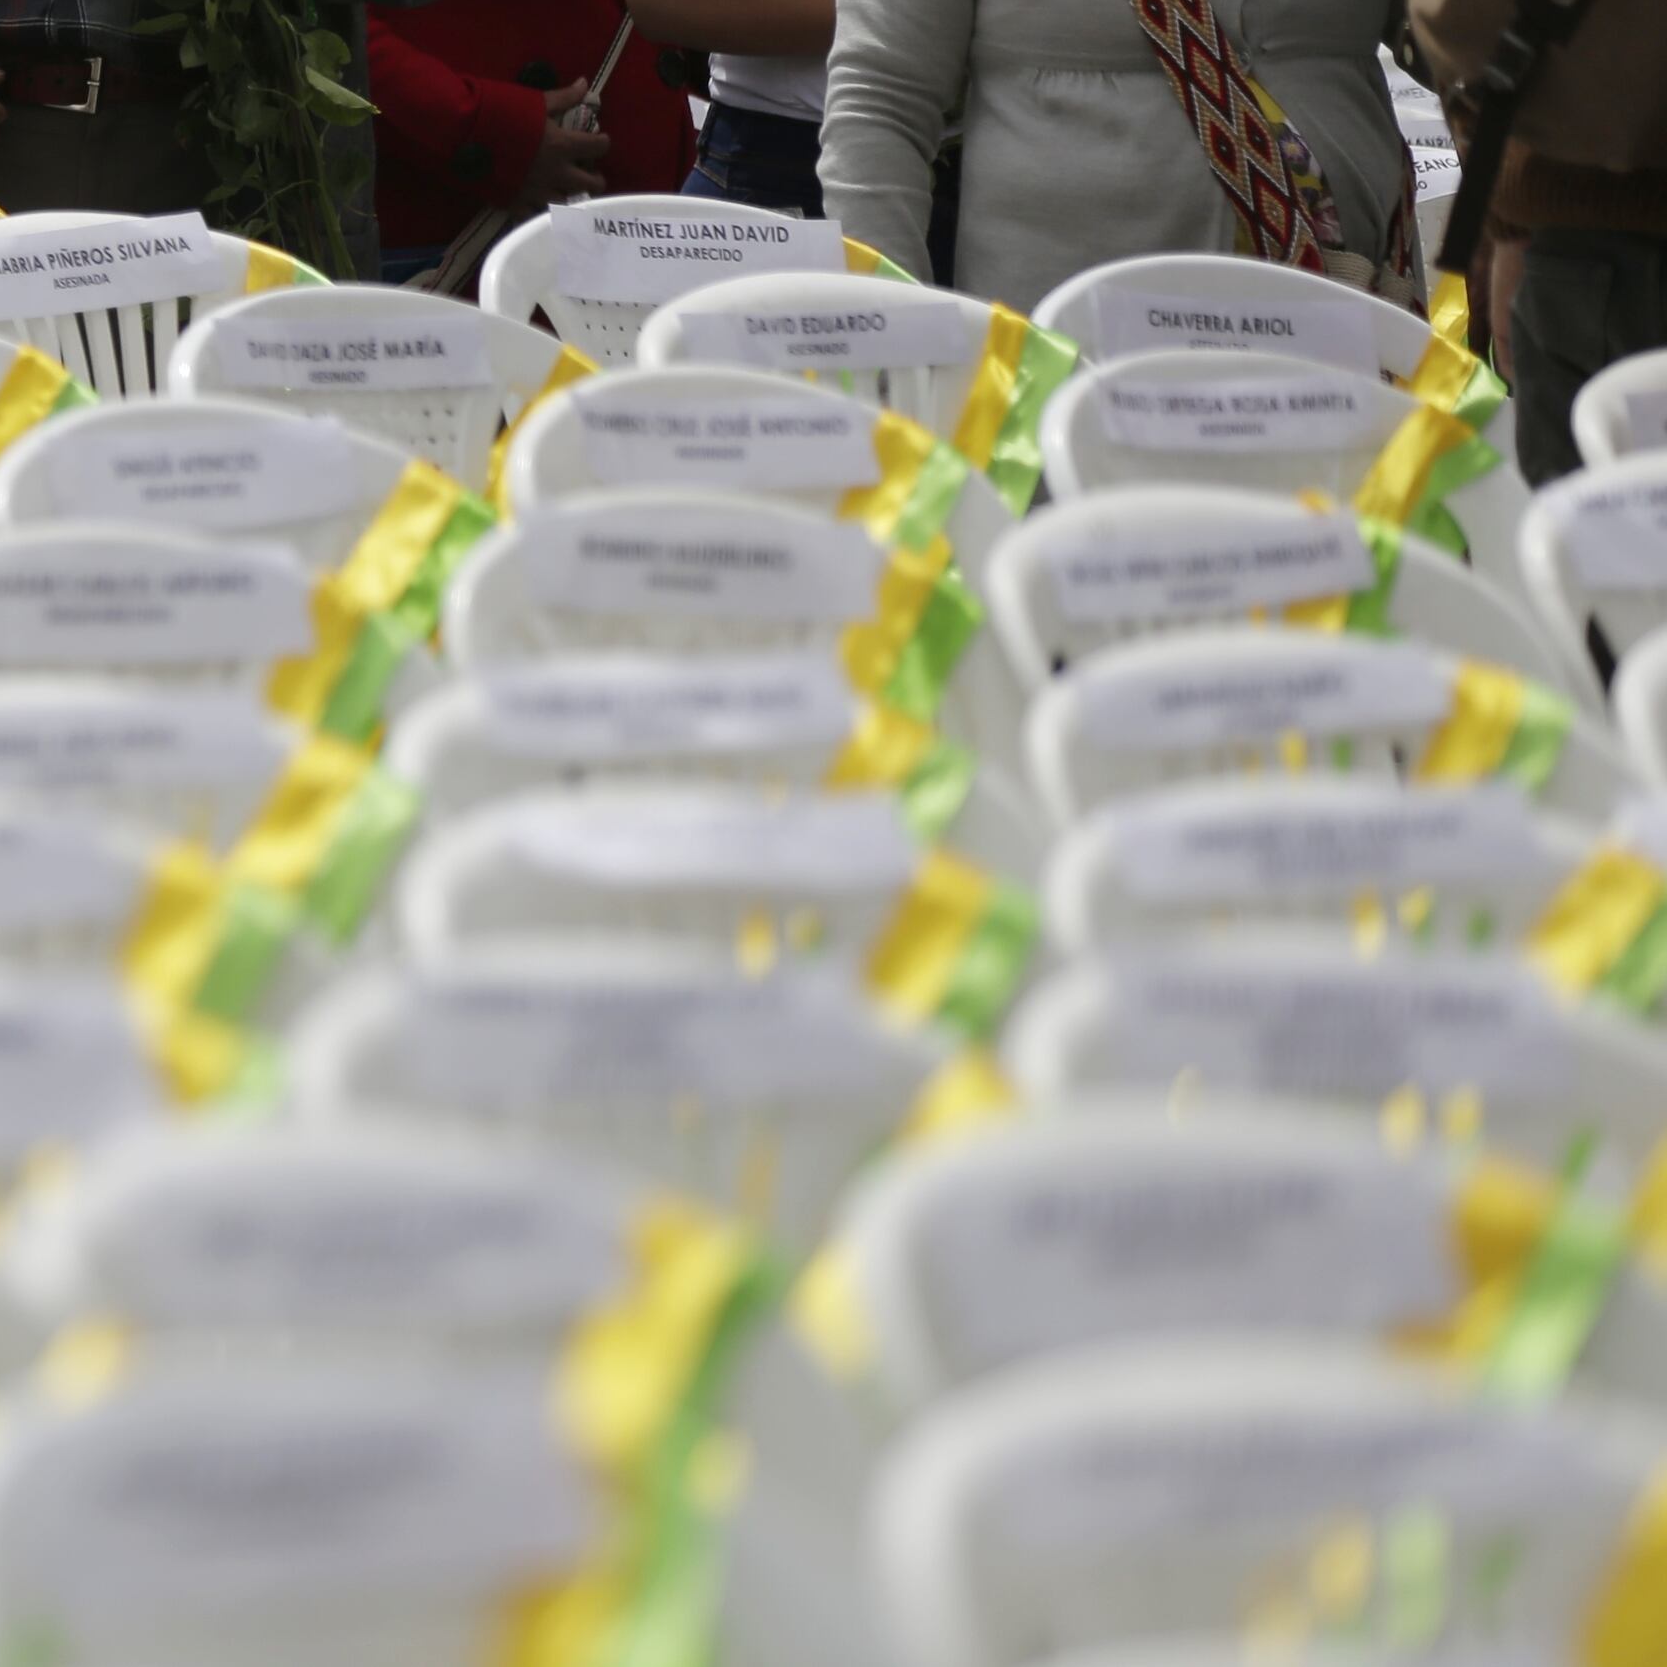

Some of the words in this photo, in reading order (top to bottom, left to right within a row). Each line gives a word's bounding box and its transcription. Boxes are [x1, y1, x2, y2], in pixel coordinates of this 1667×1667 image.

[593, 215, 675, 240] MARTÍNEZ
[679, 223, 730, 241] JUAN
[733, 225, 790, 243] DAVID
[47, 248, 116, 268] PIÑEROS
[119, 236, 193, 263] SILVANA
[640, 245, 744, 263] DESAPARECIDO
[53, 273, 111, 290] ASESINADA
[800, 312, 886, 335] EDUARDO
[1147, 308, 1235, 334] CHAVERRA
[1240, 317, 1296, 337] ARIOL
